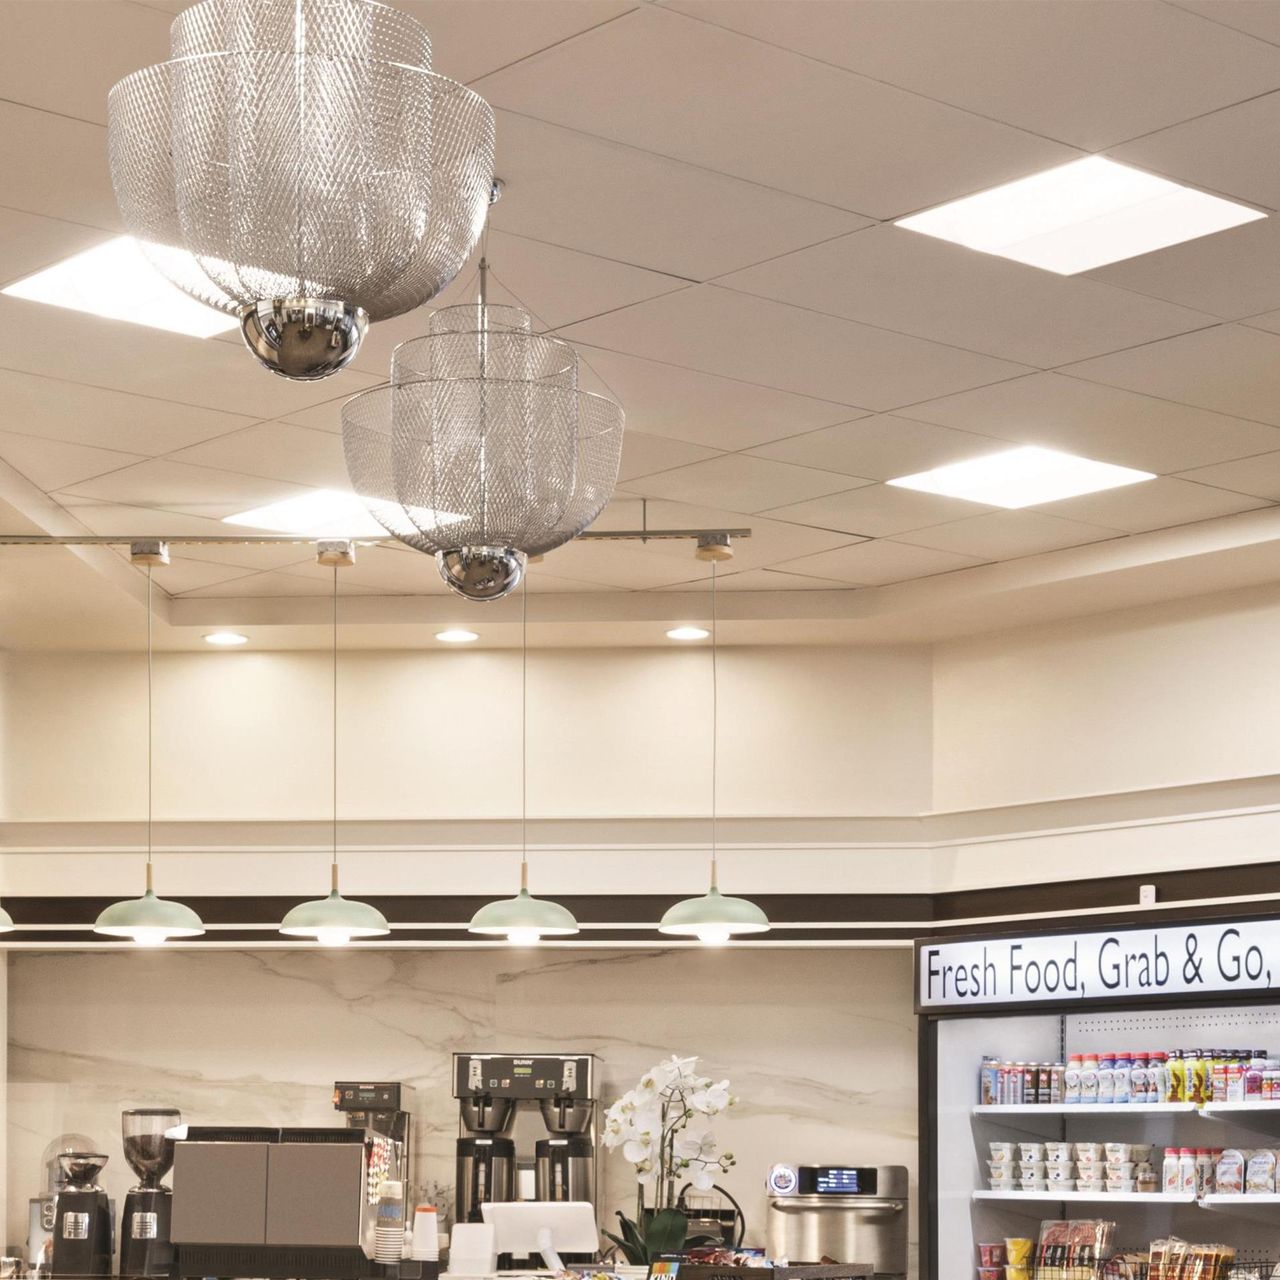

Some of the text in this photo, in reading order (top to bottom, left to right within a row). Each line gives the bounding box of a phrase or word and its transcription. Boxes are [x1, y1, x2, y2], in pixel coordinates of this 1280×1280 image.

[928, 948, 997, 999] Fresh
[1010, 940, 1086, 998] Food,
[1098, 936, 1169, 990] Grab
[1182, 933, 1203, 984] &
[1218, 928, 1272, 989] Go,
